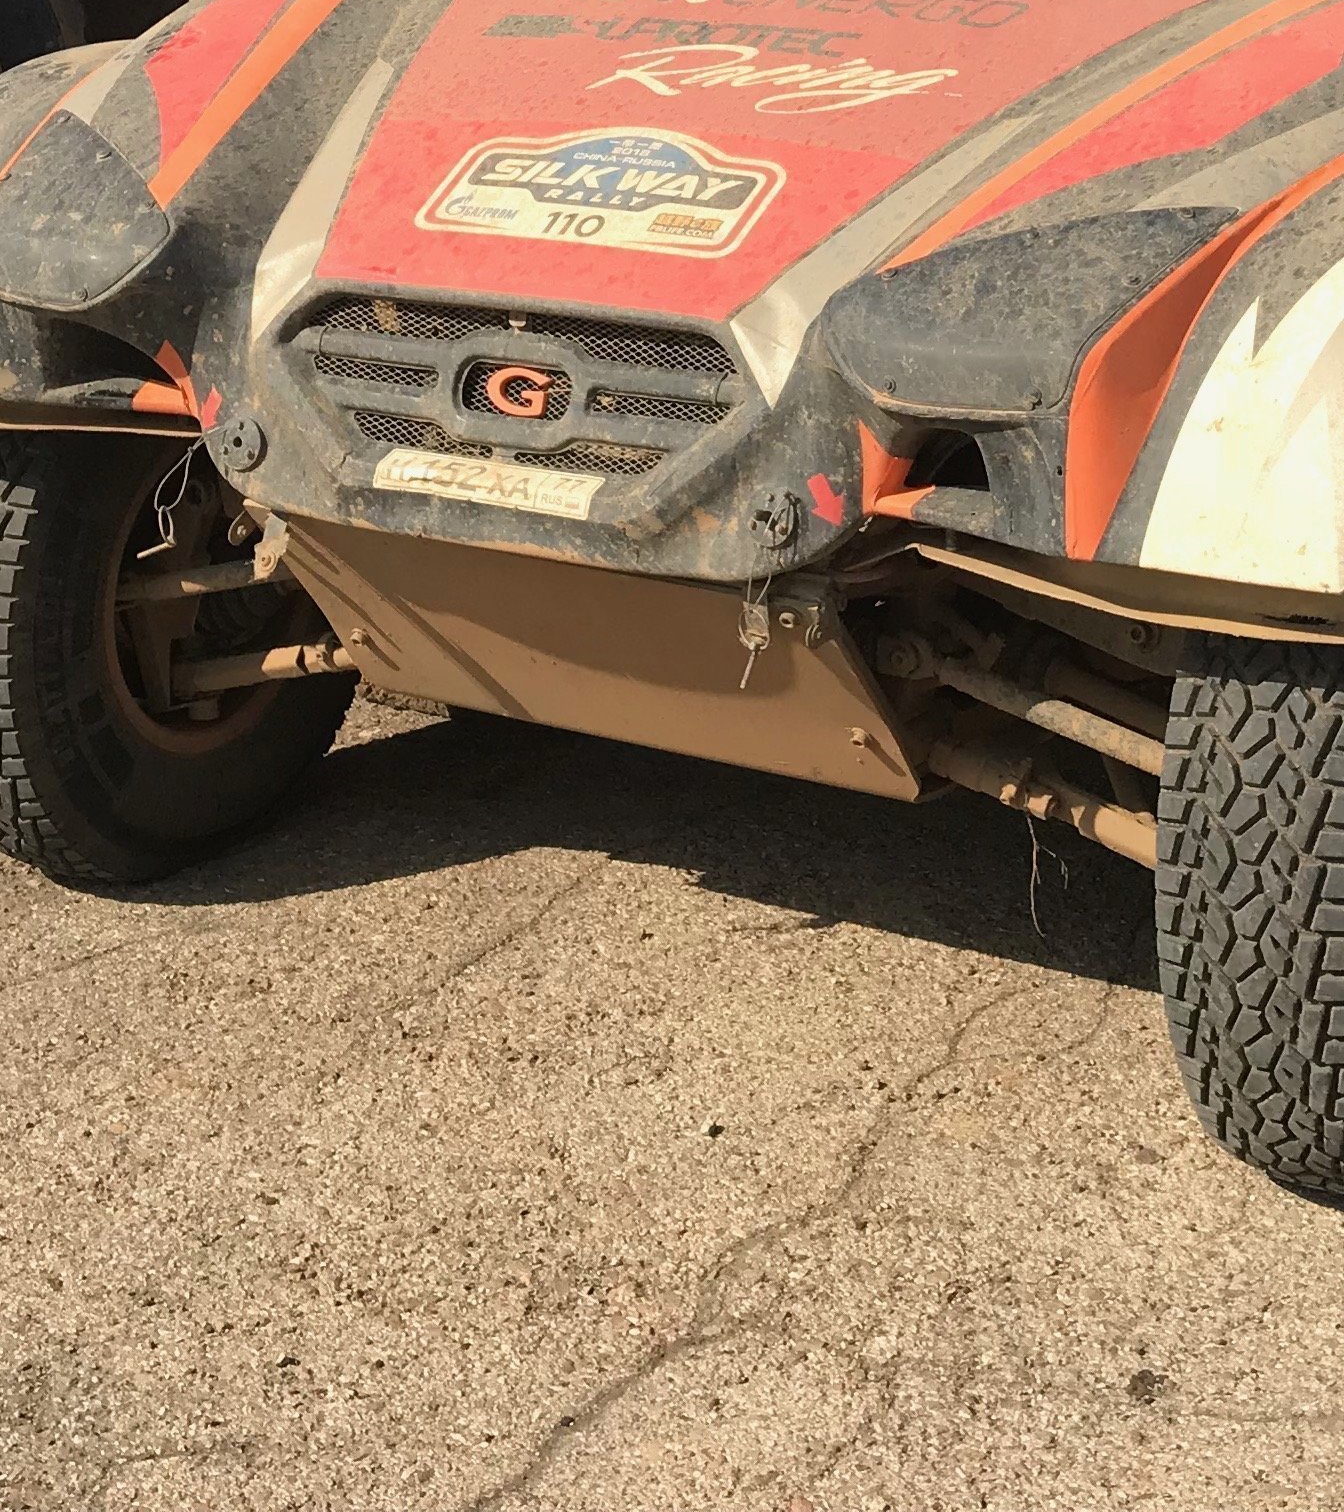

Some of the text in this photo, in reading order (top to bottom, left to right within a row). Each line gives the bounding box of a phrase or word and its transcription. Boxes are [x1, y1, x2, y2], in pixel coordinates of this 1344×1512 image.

[586, 44, 960, 114] Racing
[480, 158, 746, 202] SILK WAY
[544, 188, 648, 208] RALLY
[541, 210, 606, 239] 110
[485, 366, 558, 419] G
[541, 493, 564, 507] RUS
